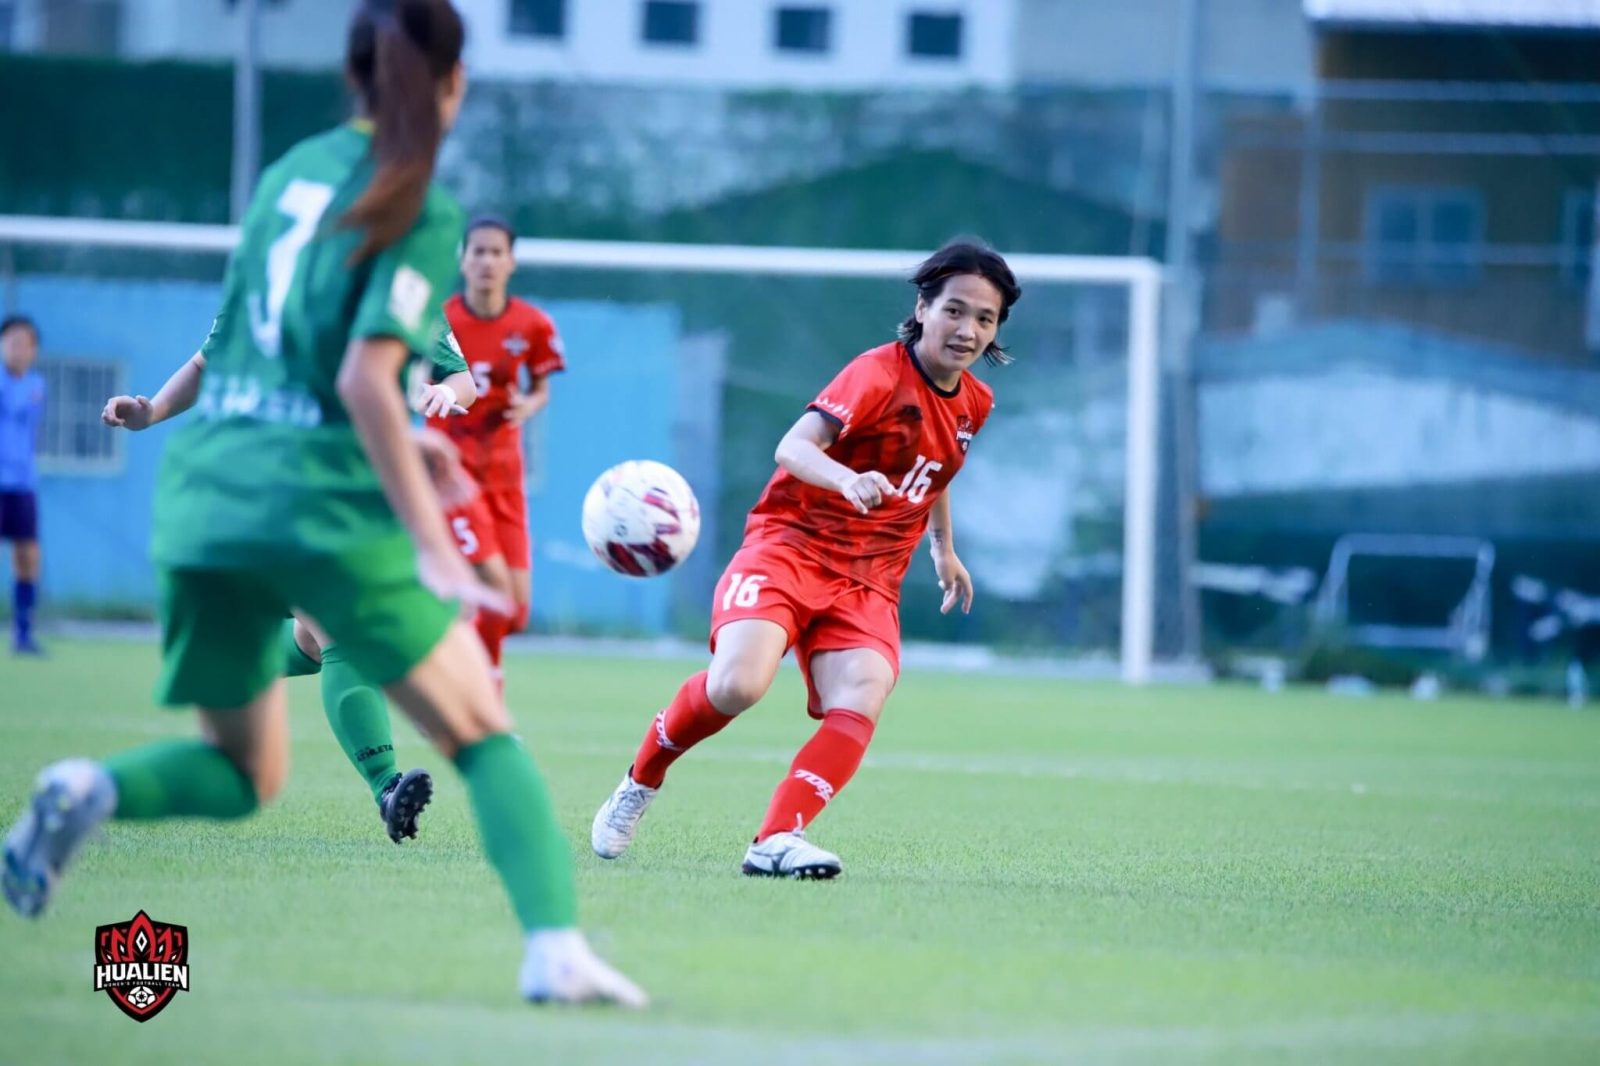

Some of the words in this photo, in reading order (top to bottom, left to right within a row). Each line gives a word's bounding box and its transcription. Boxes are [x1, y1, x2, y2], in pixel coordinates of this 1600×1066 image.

[472, 361, 492, 398] 5
[898, 454, 942, 503] 16
[452, 516, 479, 555] 5
[722, 573, 767, 611] 16
